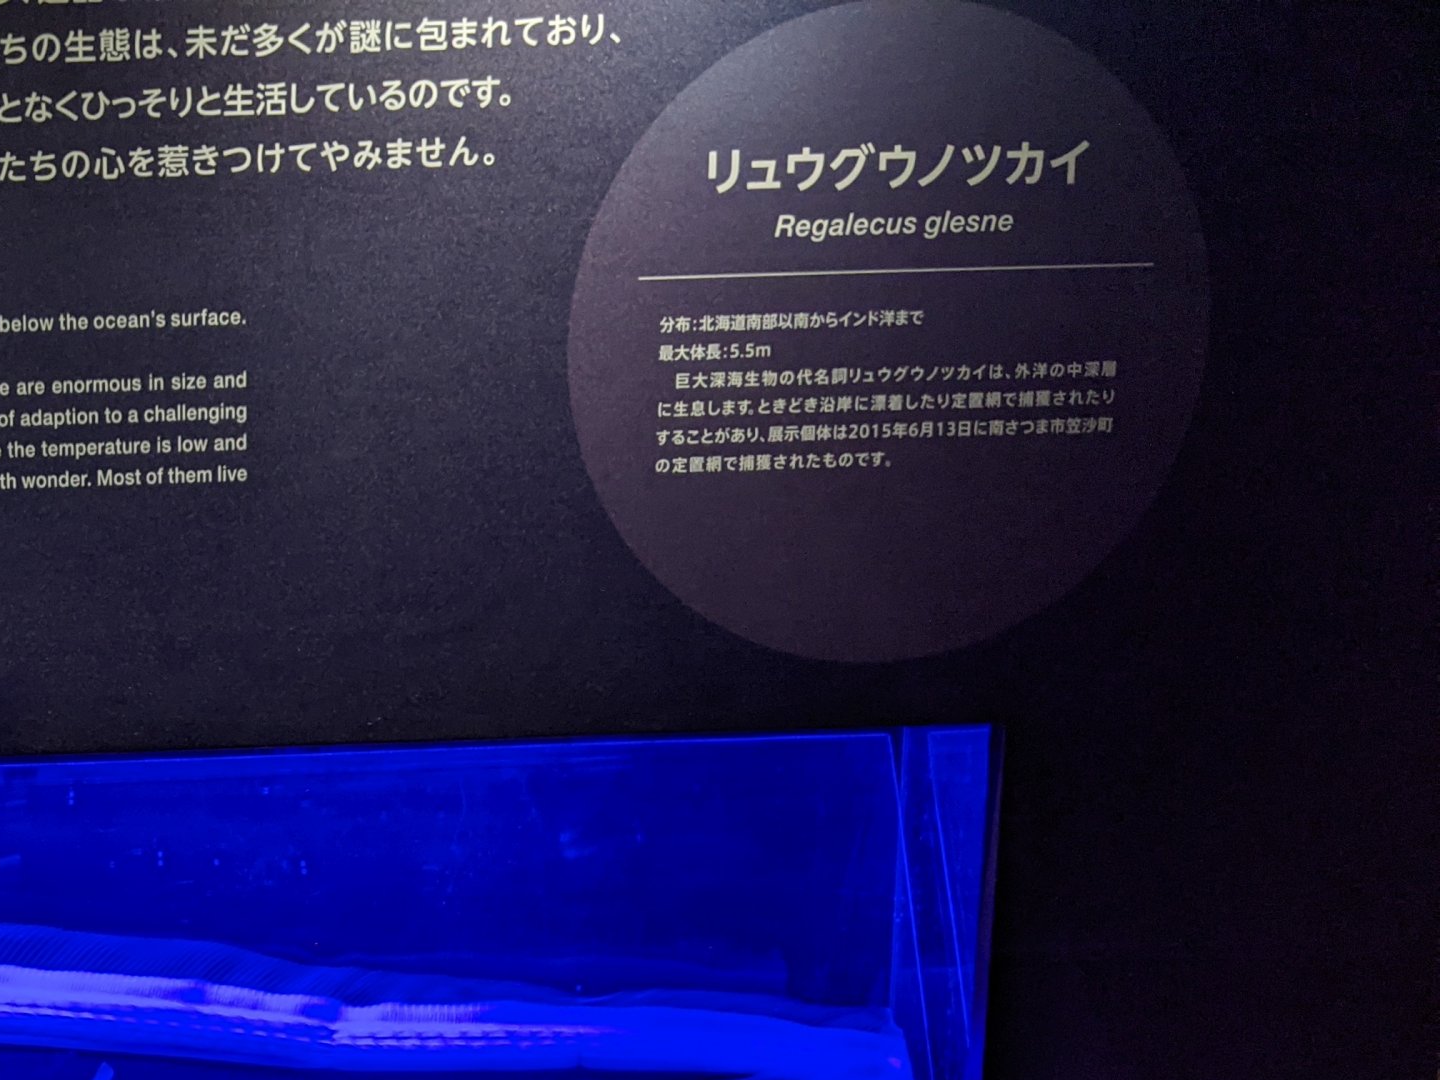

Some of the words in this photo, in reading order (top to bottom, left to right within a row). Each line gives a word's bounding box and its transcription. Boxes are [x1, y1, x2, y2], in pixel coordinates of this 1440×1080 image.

[707, 140, 1090, 194] リュウグウノツカイ
[774, 212, 918, 243] Regalecus
[923, 209, 1014, 240] glesne
[58, 312, 89, 331] the
[92, 309, 166, 330] ocean's
[170, 307, 247, 328] surface.
[16, 380, 46, 396] are
[51, 377, 142, 395] enormous
[148, 373, 165, 392] in
[171, 372, 207, 391] size
[213, 369, 248, 389] and
[20, 407, 99, 430] adaption
[103, 407, 123, 424] to
[127, 409, 139, 424] a
[143, 402, 248, 425] challenging
[6, 440, 36, 459] the
[40, 437, 151, 460] temperature
[156, 435, 172, 454] is
[177, 435, 209, 453] low
[213, 432, 248, 452] and
[20, 470, 92, 490] wonder.
[96, 468, 142, 487] Most
[145, 466, 164, 485] of
[167, 466, 213, 485] them
[217, 464, 248, 483] live
